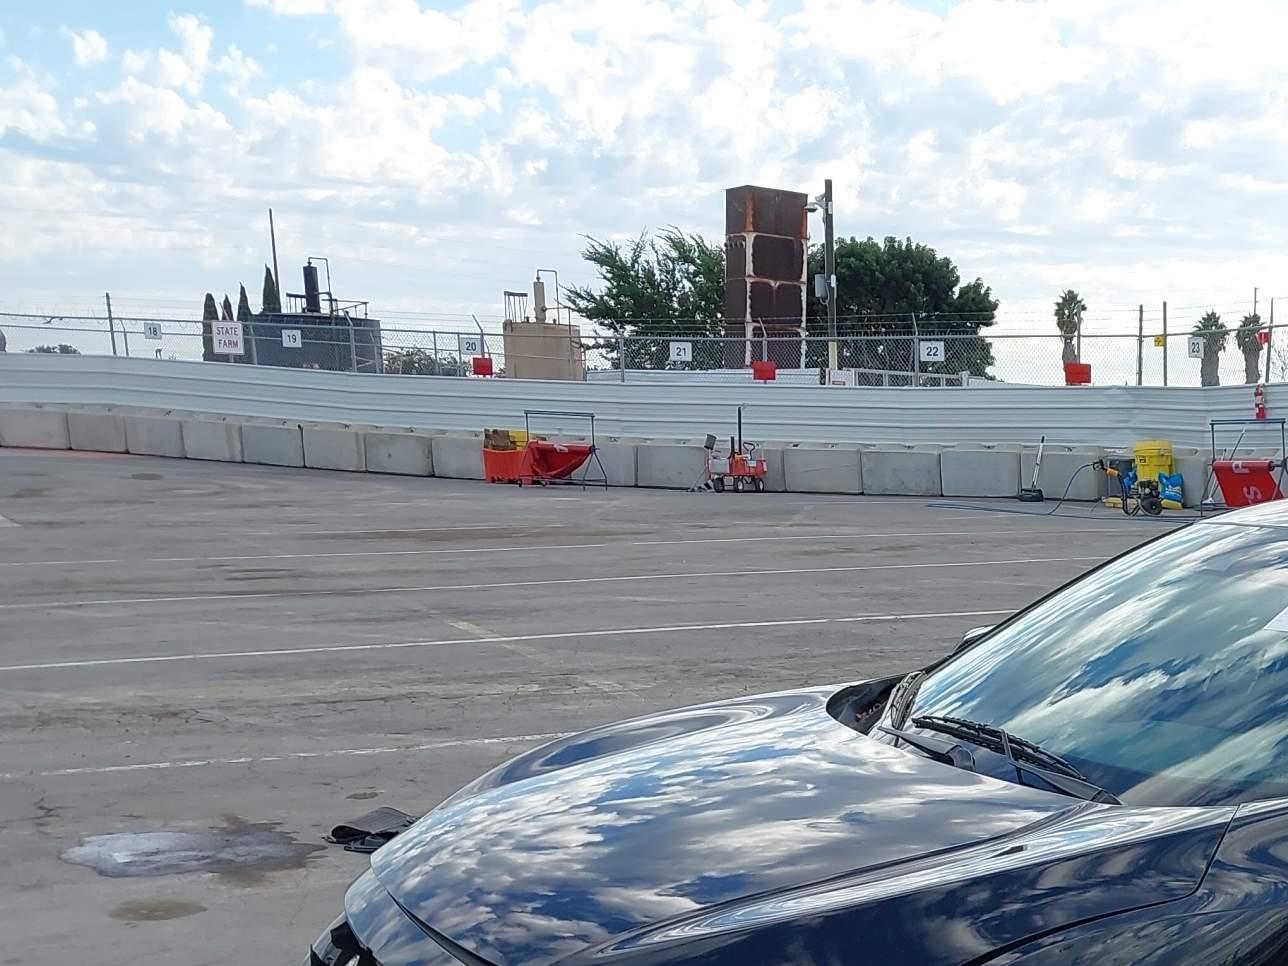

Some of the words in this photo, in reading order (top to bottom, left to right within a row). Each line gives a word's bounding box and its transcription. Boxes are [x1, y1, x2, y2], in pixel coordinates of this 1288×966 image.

[149, 327, 157, 337] 18
[216, 327, 238, 337] STATE
[217, 338, 239, 349] FARM
[287, 334, 299, 345] 19
[465, 342, 477, 353] 20
[675, 346, 687, 357] 21
[926, 344, 939, 358] 22
[1192, 342, 1201, 354] 23
